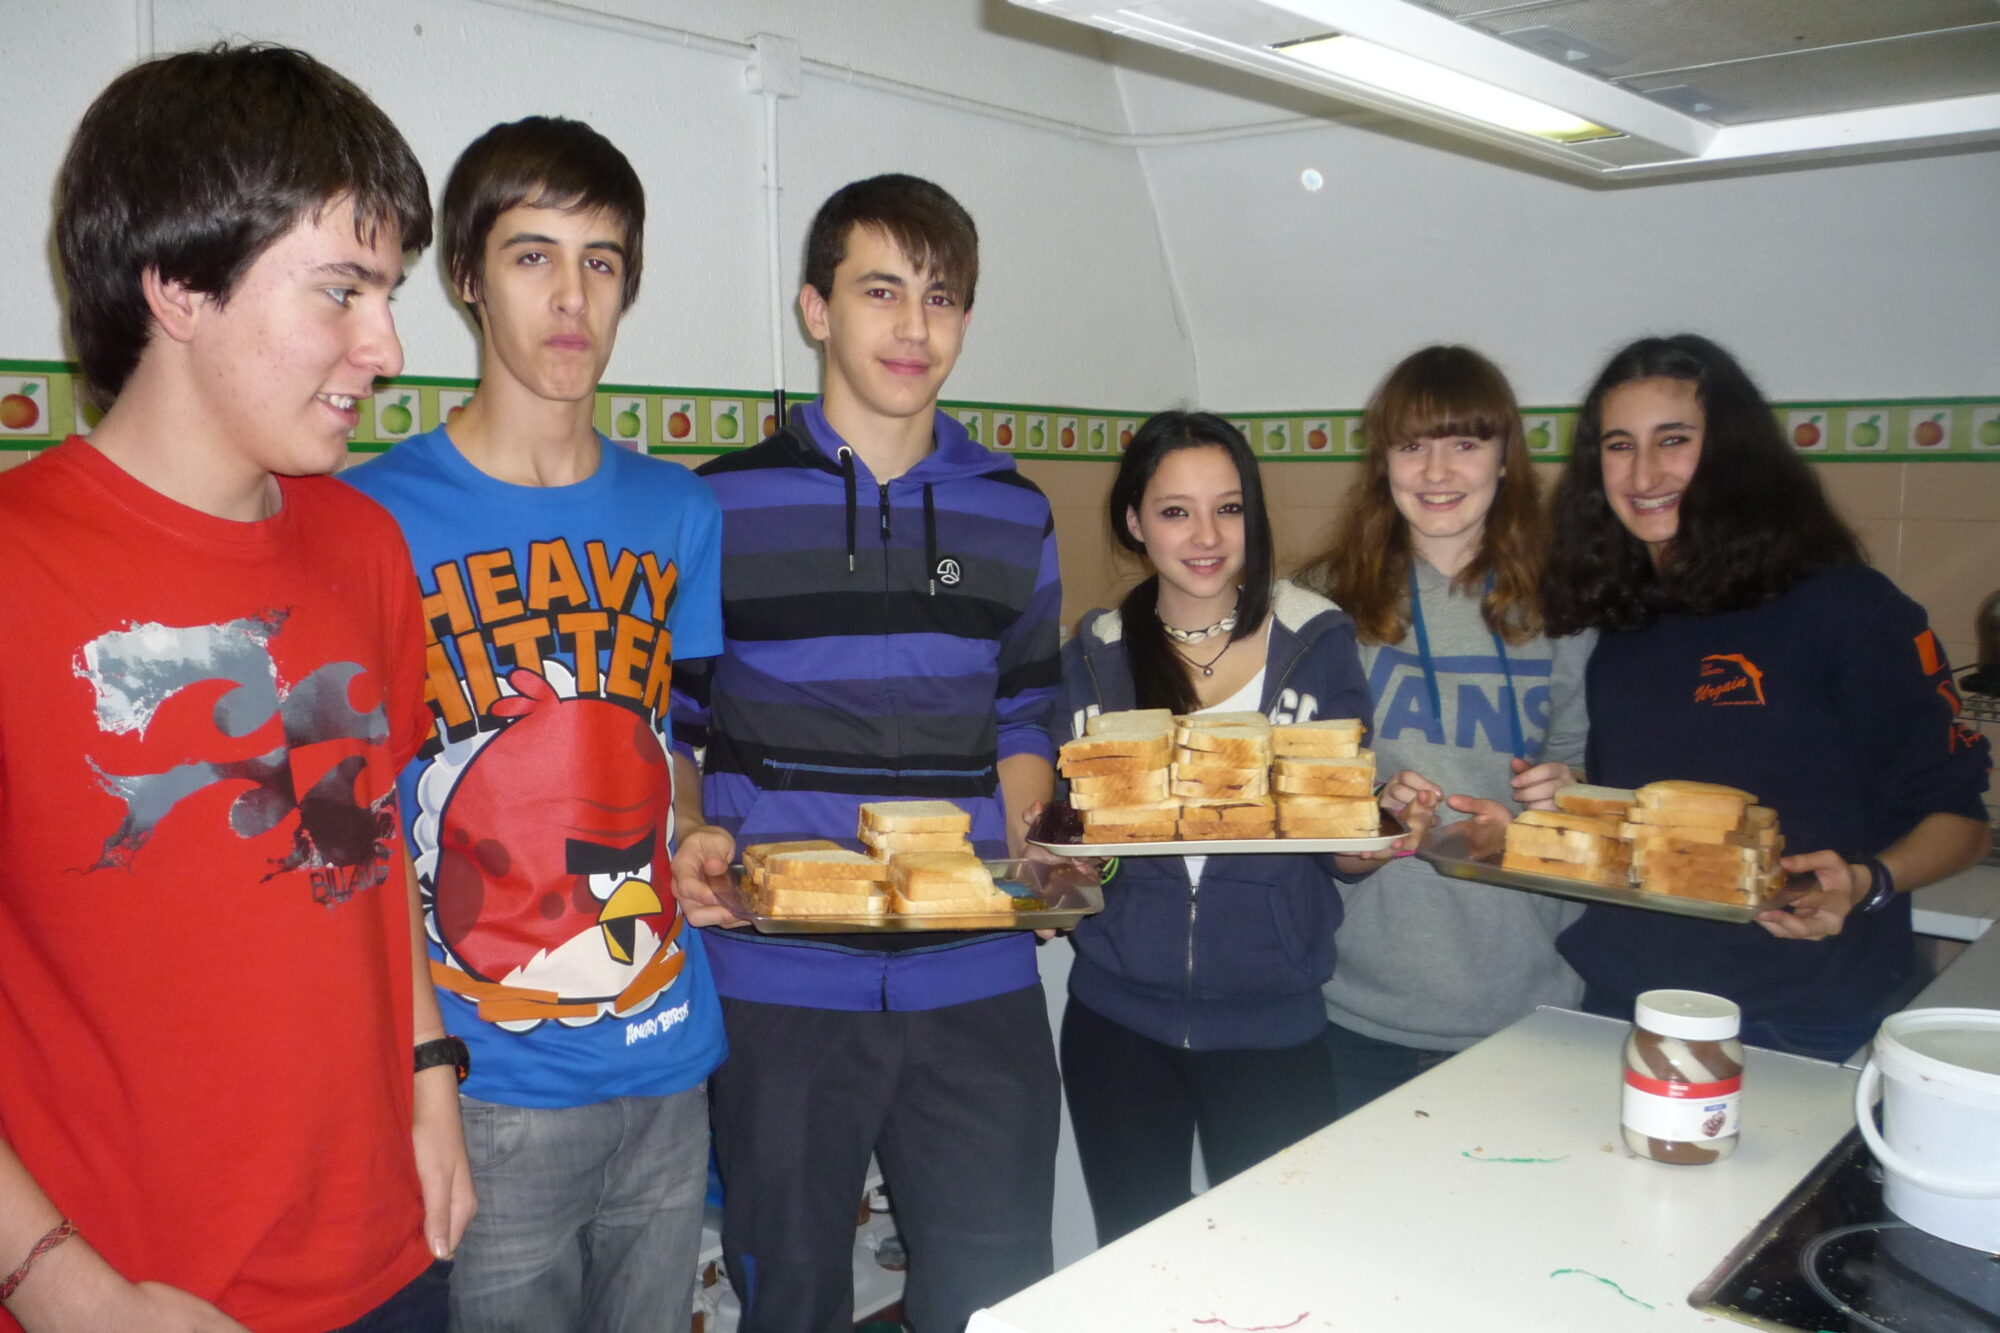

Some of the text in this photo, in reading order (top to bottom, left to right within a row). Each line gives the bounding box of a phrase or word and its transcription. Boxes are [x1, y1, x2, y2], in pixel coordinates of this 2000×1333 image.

[421, 537, 679, 645] HEAVY
[626, 1002, 690, 1046] ANGRY BIRDS
